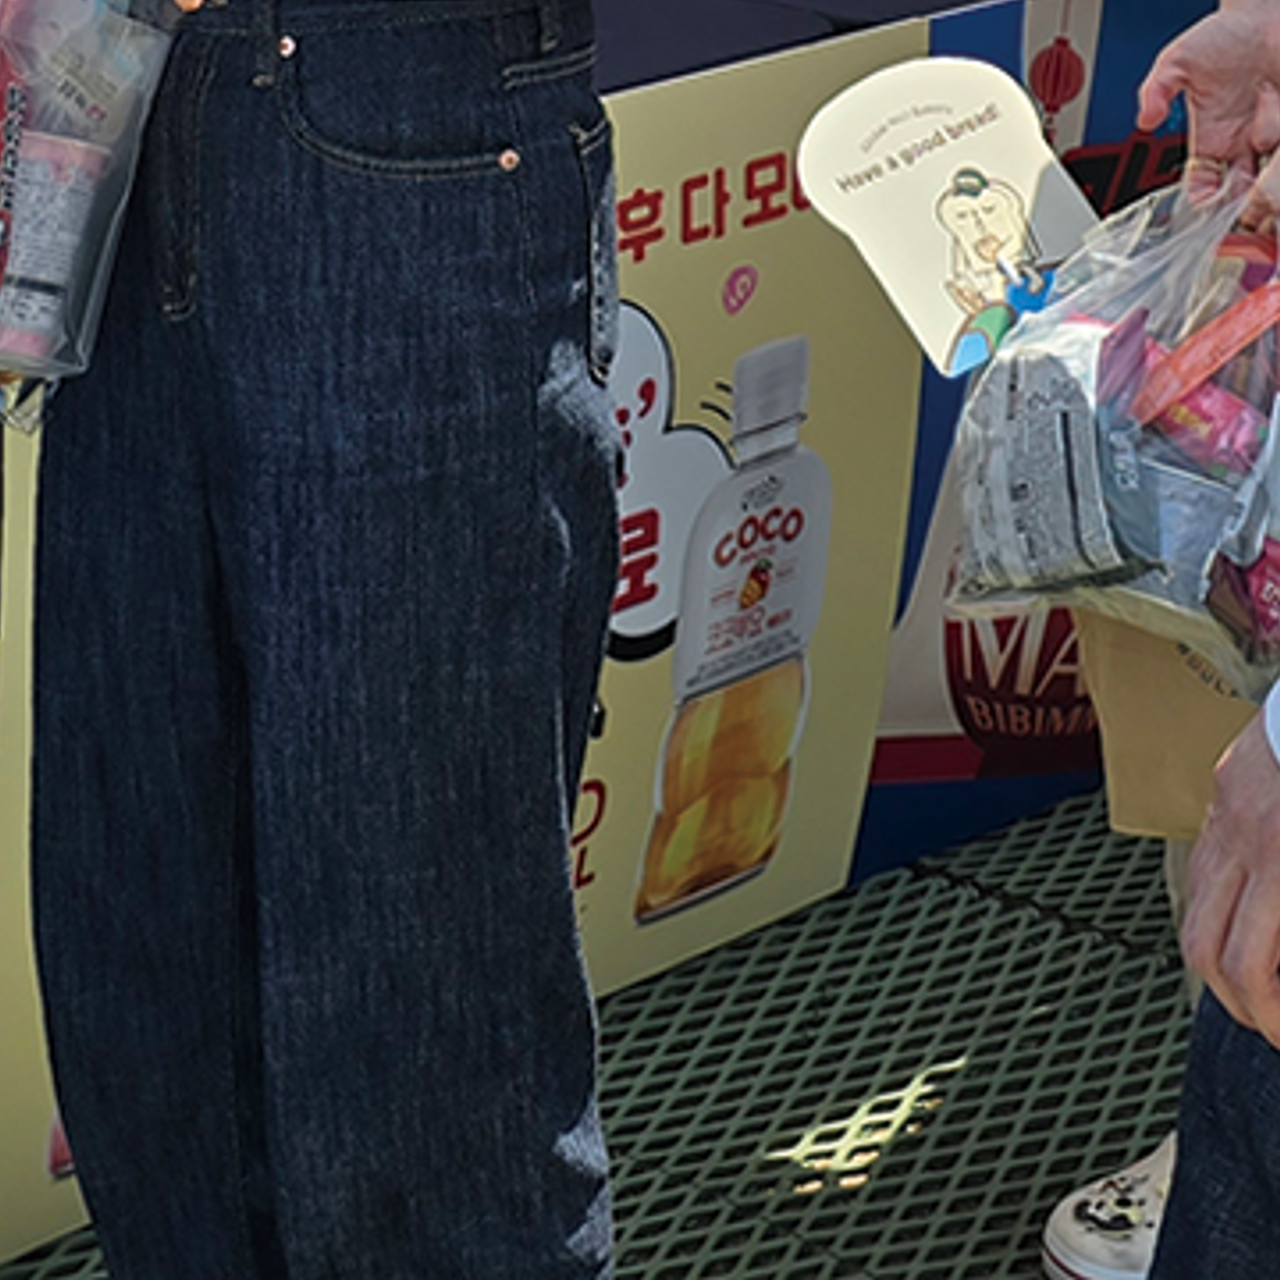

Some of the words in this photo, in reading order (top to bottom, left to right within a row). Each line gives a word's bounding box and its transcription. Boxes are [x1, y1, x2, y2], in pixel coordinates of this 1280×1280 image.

[836, 160, 884, 193] Have
[885, 153, 900, 173] a
[898, 129, 947, 166] good
